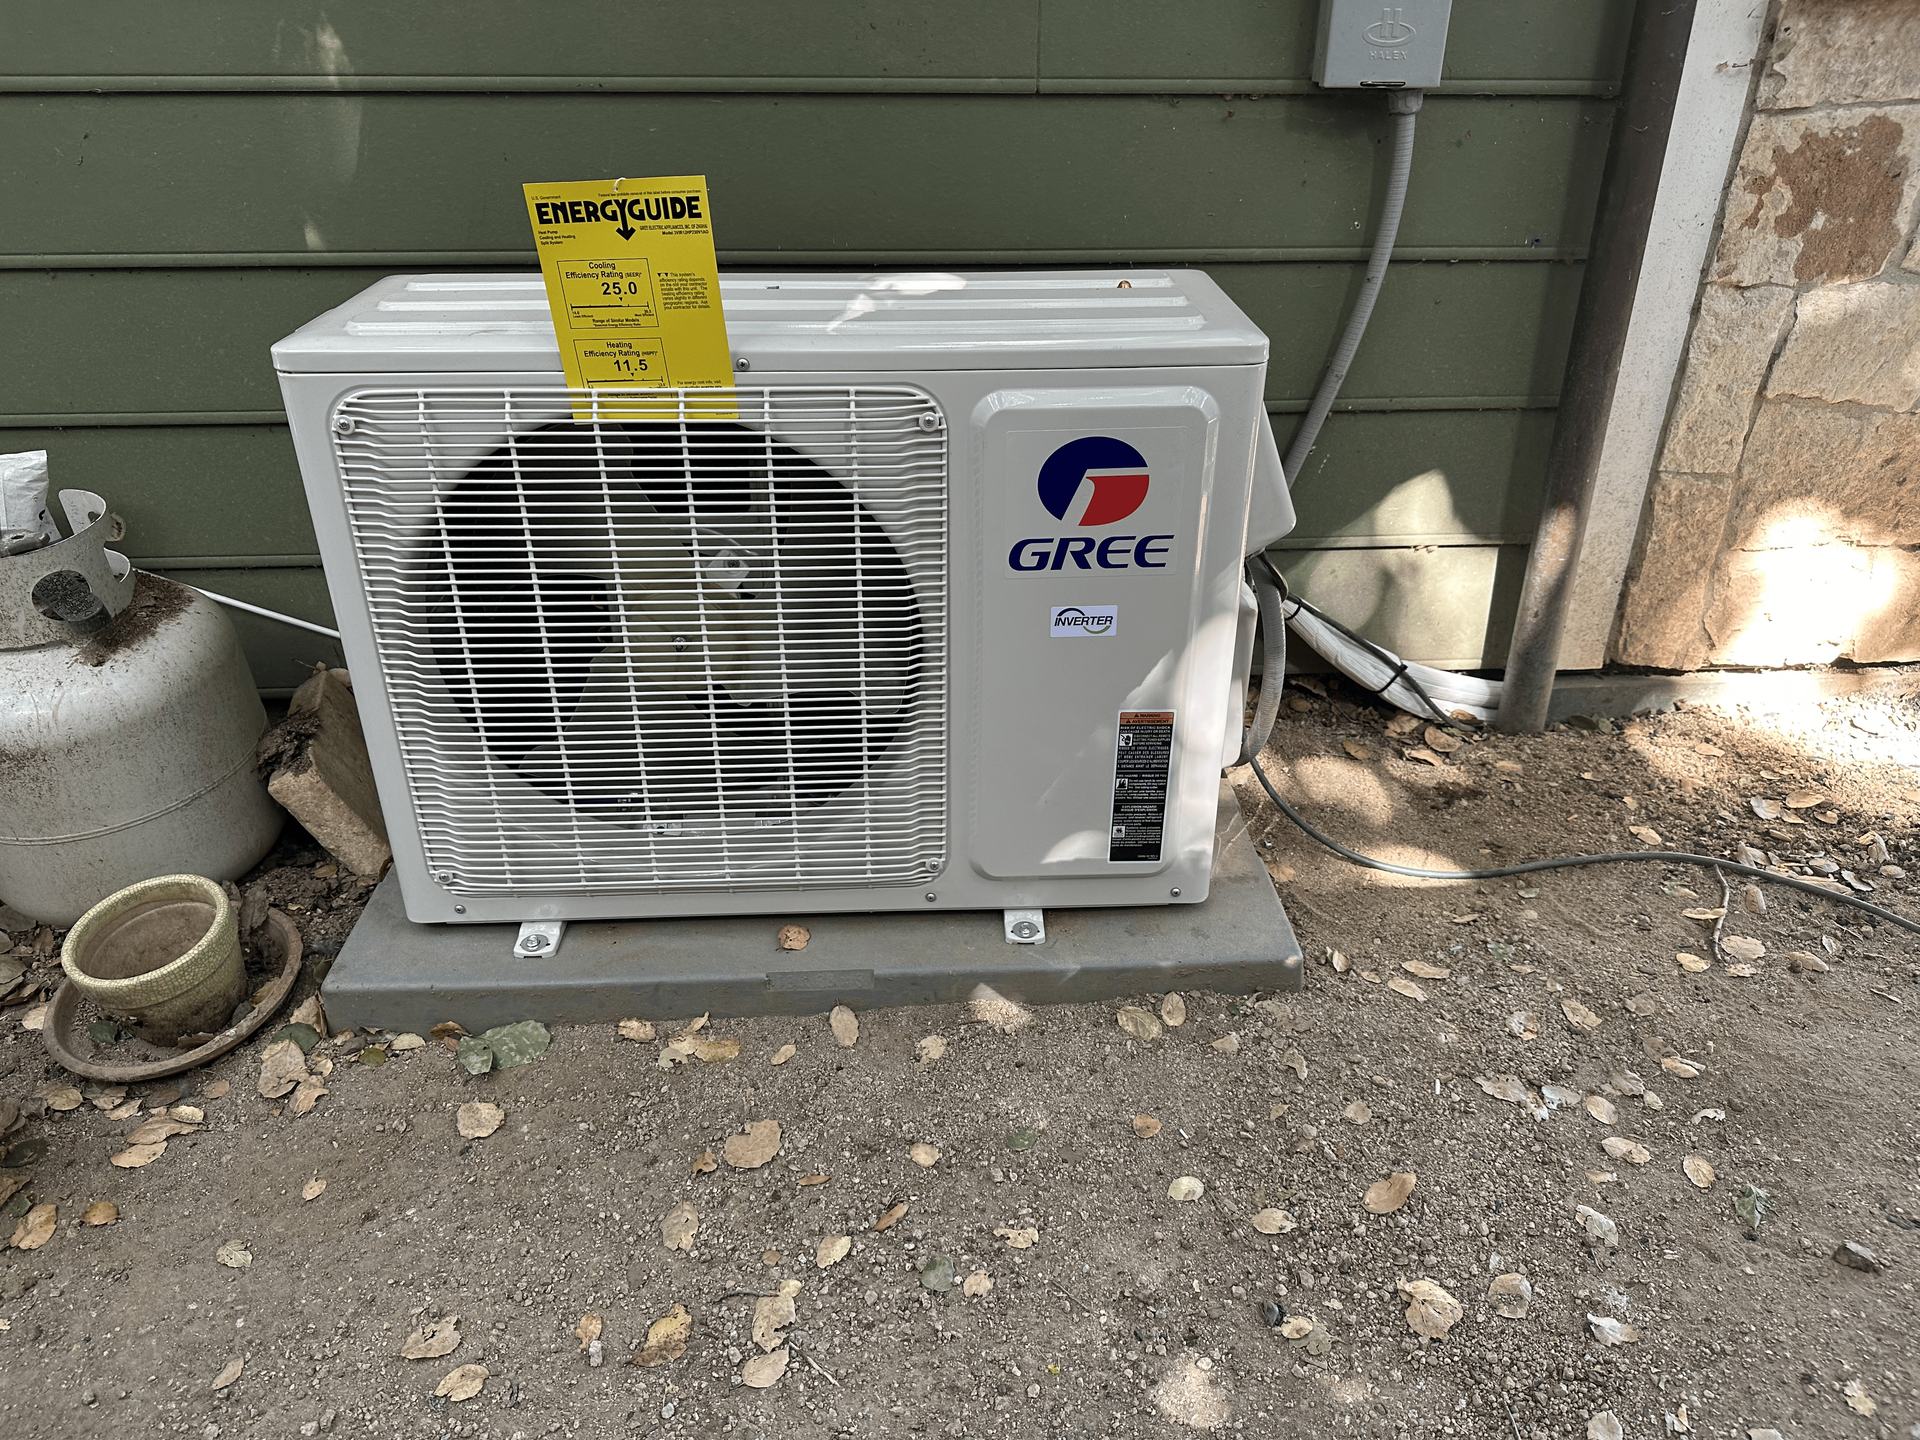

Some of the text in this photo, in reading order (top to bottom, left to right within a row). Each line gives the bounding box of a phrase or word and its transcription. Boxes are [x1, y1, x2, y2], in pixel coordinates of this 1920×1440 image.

[1368, 50, 1408, 61] HALEX
[535, 196, 702, 226] ENERGYGUIDE
[588, 262, 616, 270] Cooling
[565, 272, 600, 280] Efficiency
[600, 271, 624, 280] Rating
[601, 282, 638, 295] 25.0
[614, 359, 648, 372] 11.5
[1008, 534, 1175, 572] GREE
[1054, 616, 1114, 626] INVERTER
